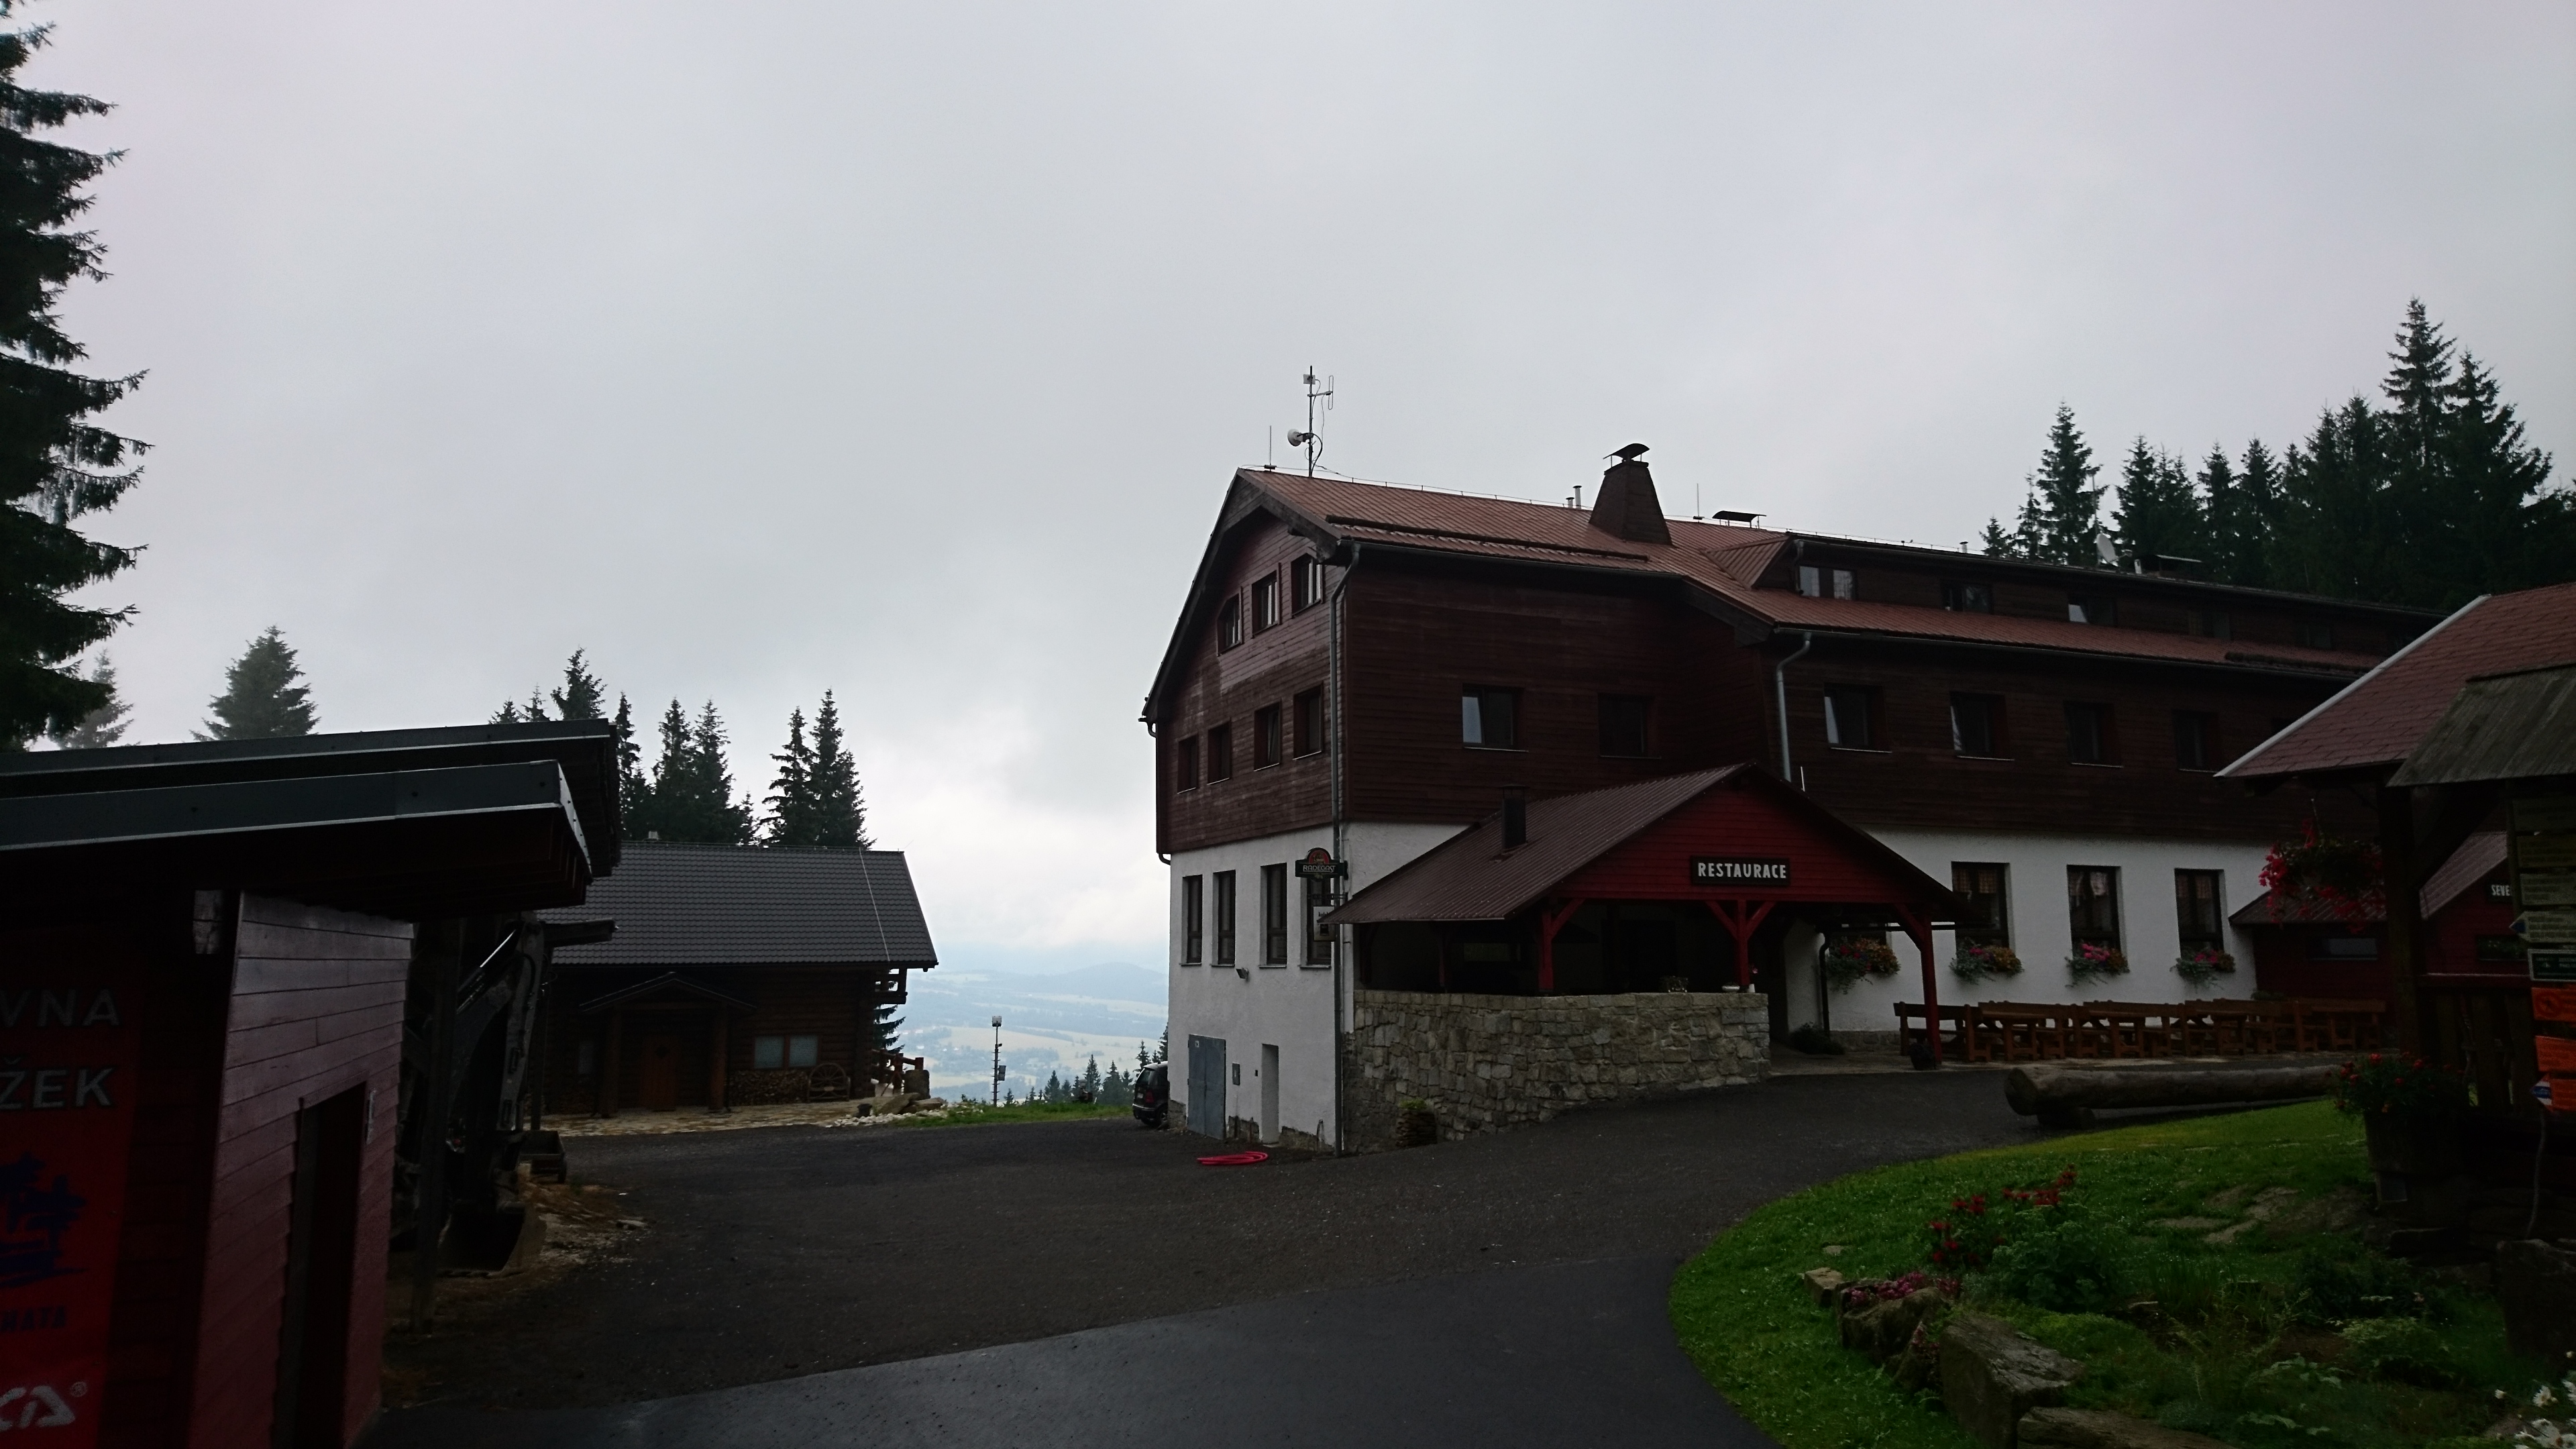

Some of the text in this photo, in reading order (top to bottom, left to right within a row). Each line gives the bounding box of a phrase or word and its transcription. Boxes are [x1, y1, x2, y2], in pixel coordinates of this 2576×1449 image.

[1303, 865, 1336, 873] RADEGAST
[1697, 862, 1787, 879] RESTAURACE
[0, 988, 122, 1028] VNA
[0, 1056, 115, 1110] ŽEK
